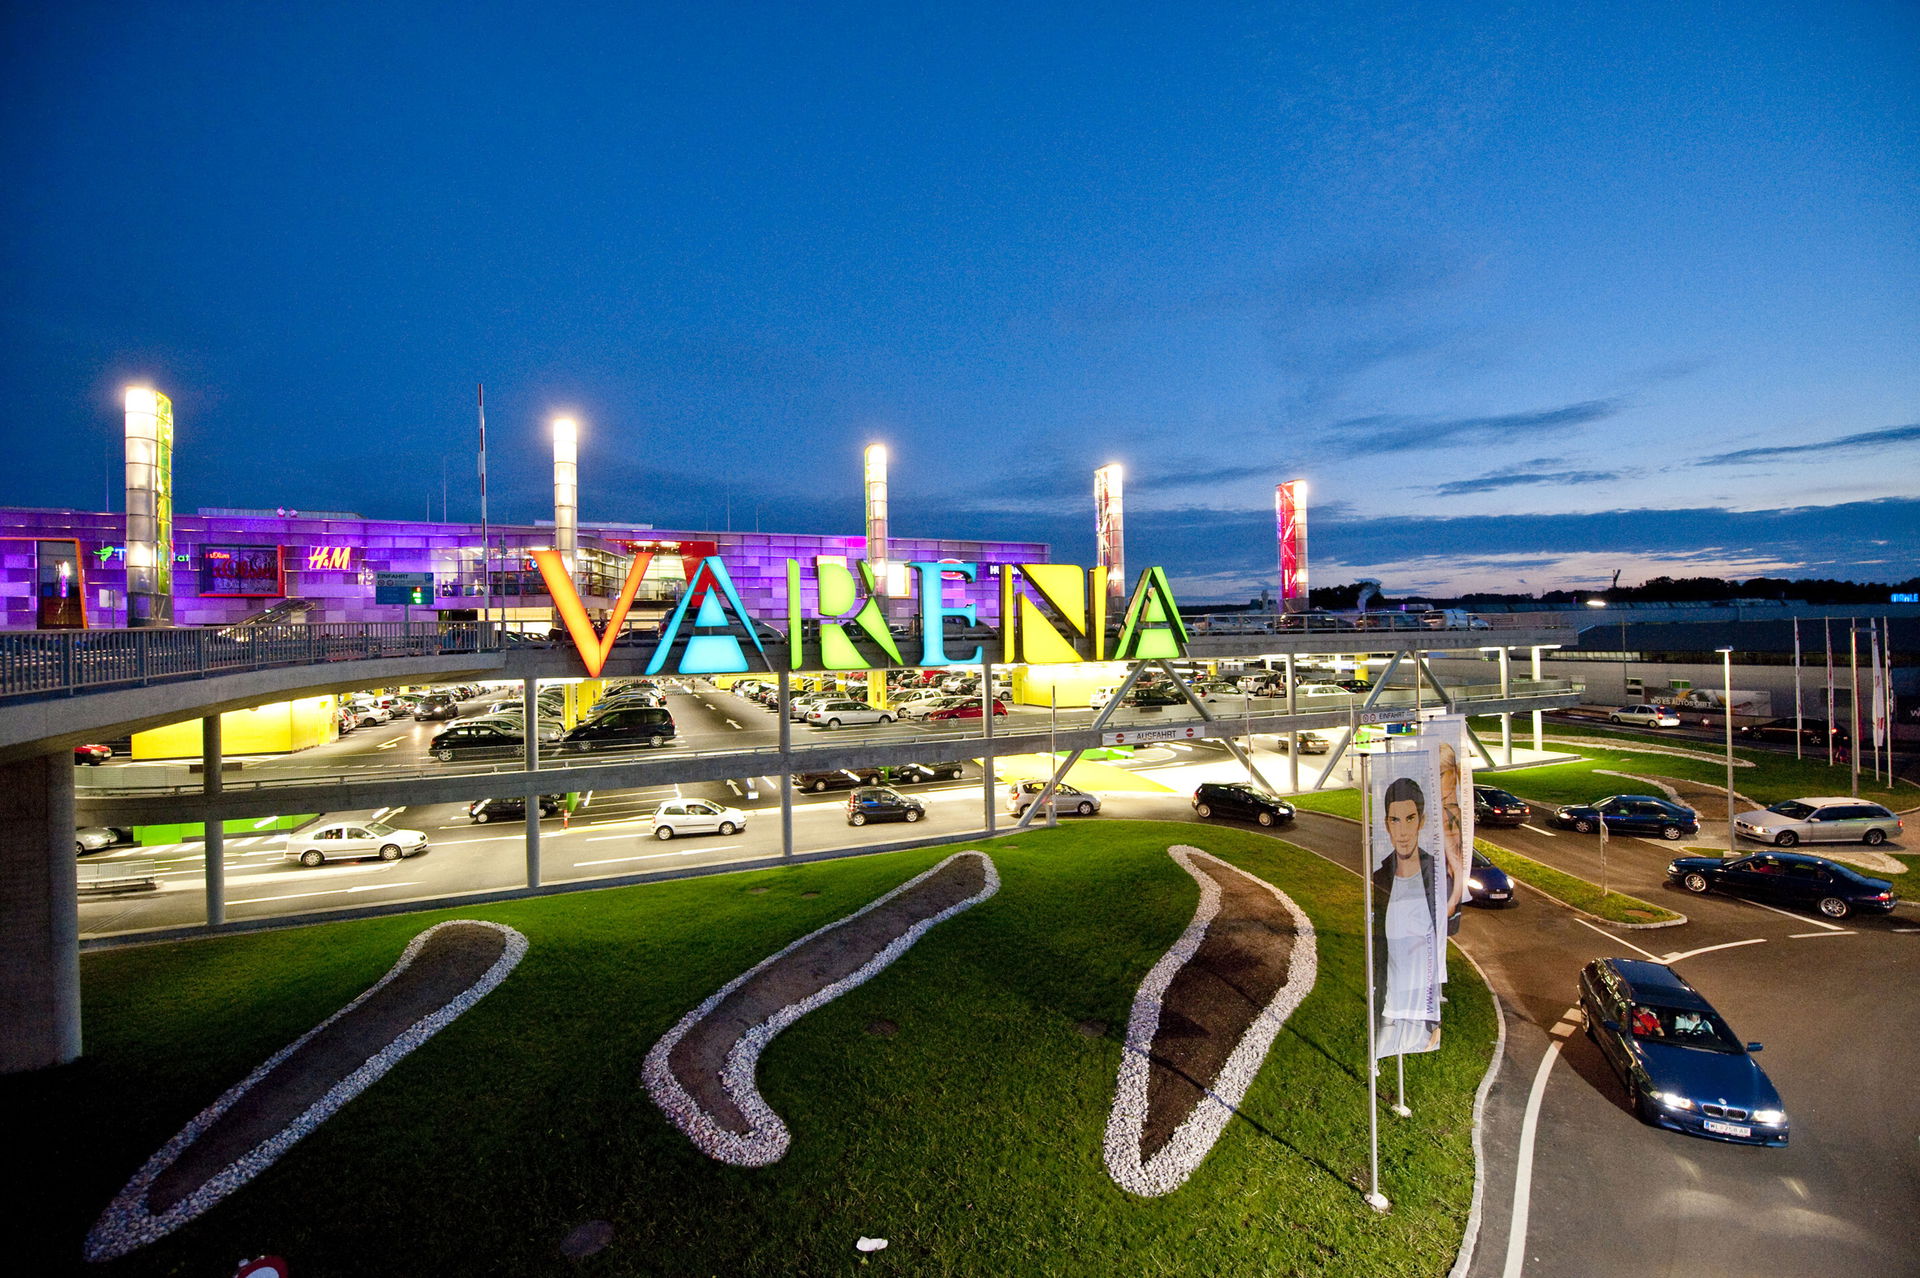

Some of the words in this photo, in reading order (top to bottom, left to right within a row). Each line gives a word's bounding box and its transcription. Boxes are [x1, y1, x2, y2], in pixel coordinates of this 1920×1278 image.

[308, 546, 351, 570] H&M
[528, 549, 1190, 678] VARENA
[1379, 711, 1405, 720] EINFAHRT
[1136, 730, 1177, 741] AUSFAHRT
